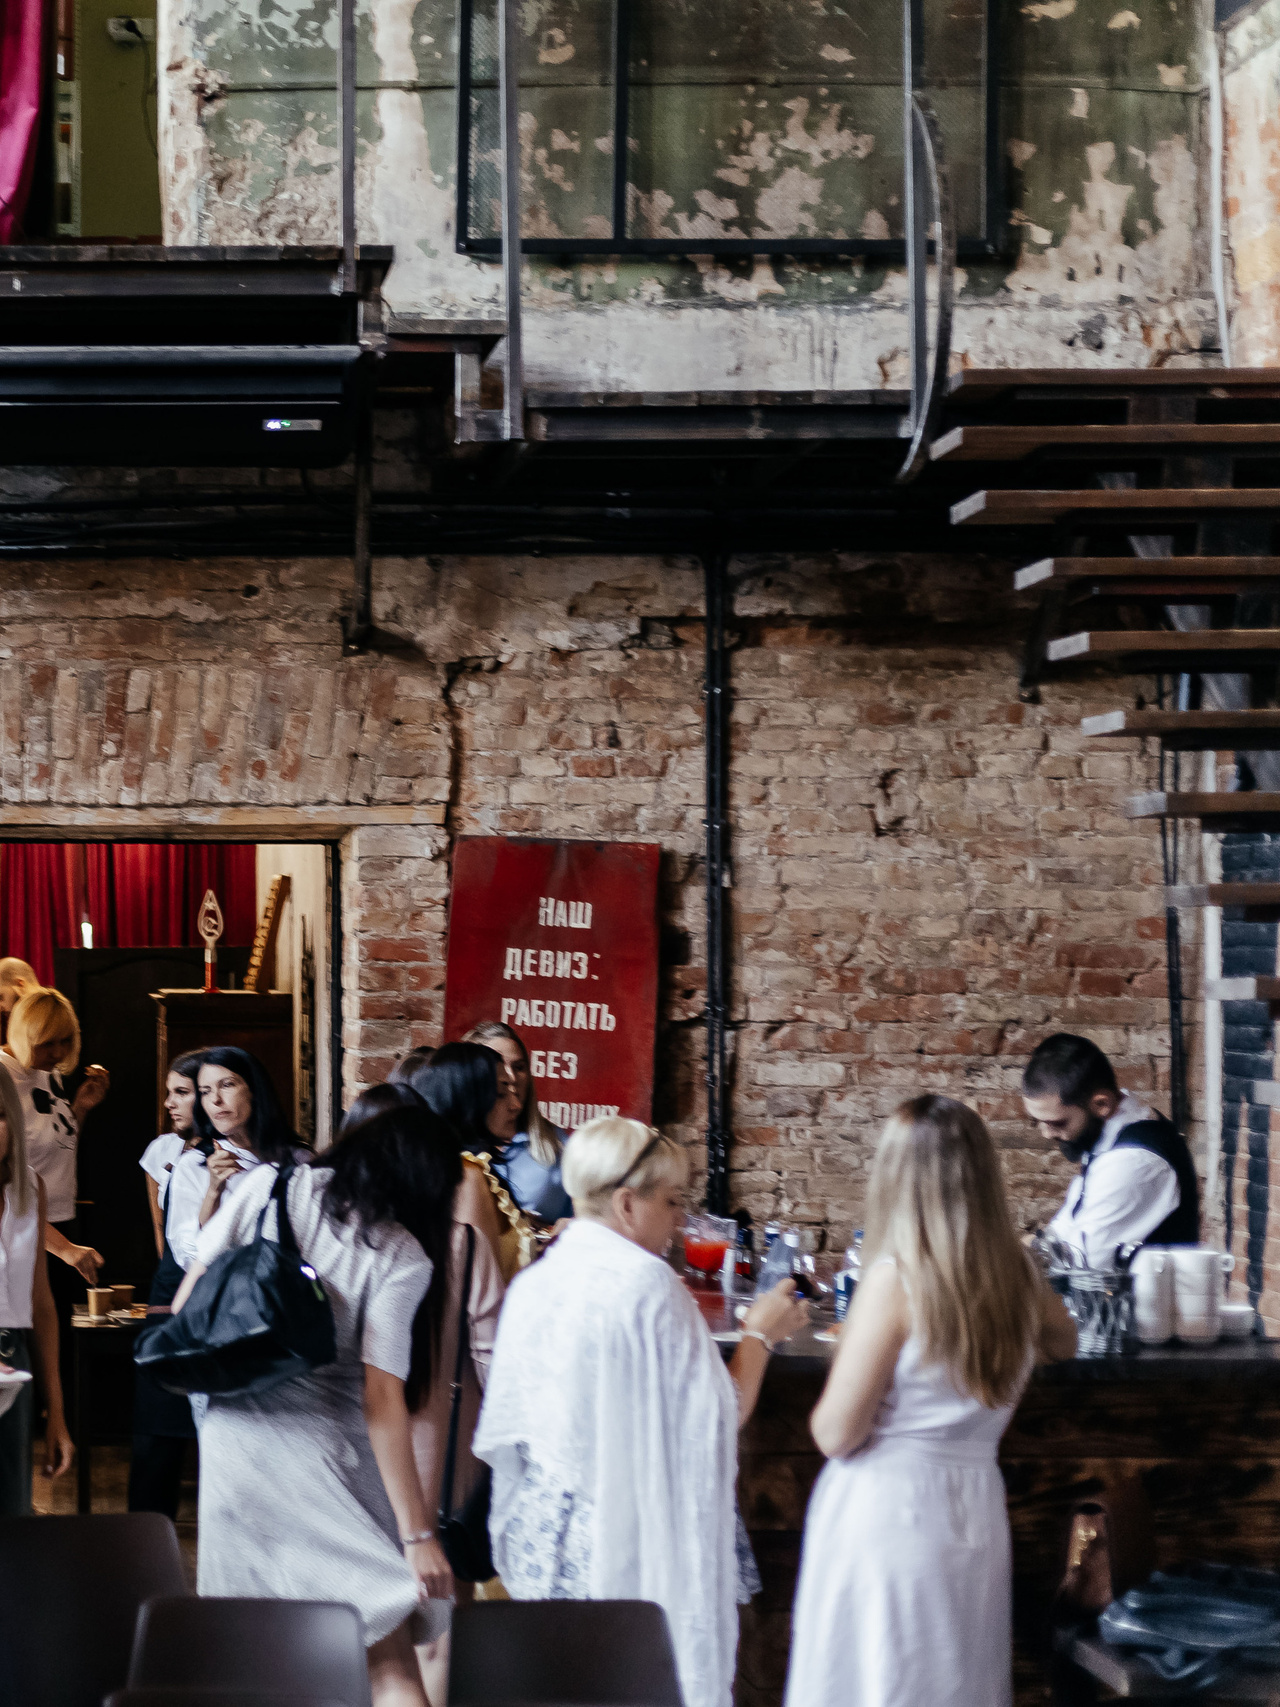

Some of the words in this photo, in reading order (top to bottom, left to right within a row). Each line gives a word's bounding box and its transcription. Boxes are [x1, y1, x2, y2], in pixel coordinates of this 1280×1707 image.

[538, 897, 592, 929] НАШ
[503, 947, 601, 980] ДЕВИЗ:
[501, 997, 616, 1031] РАБОТАТЬ
[530, 1050, 578, 1079] БЕЗ
